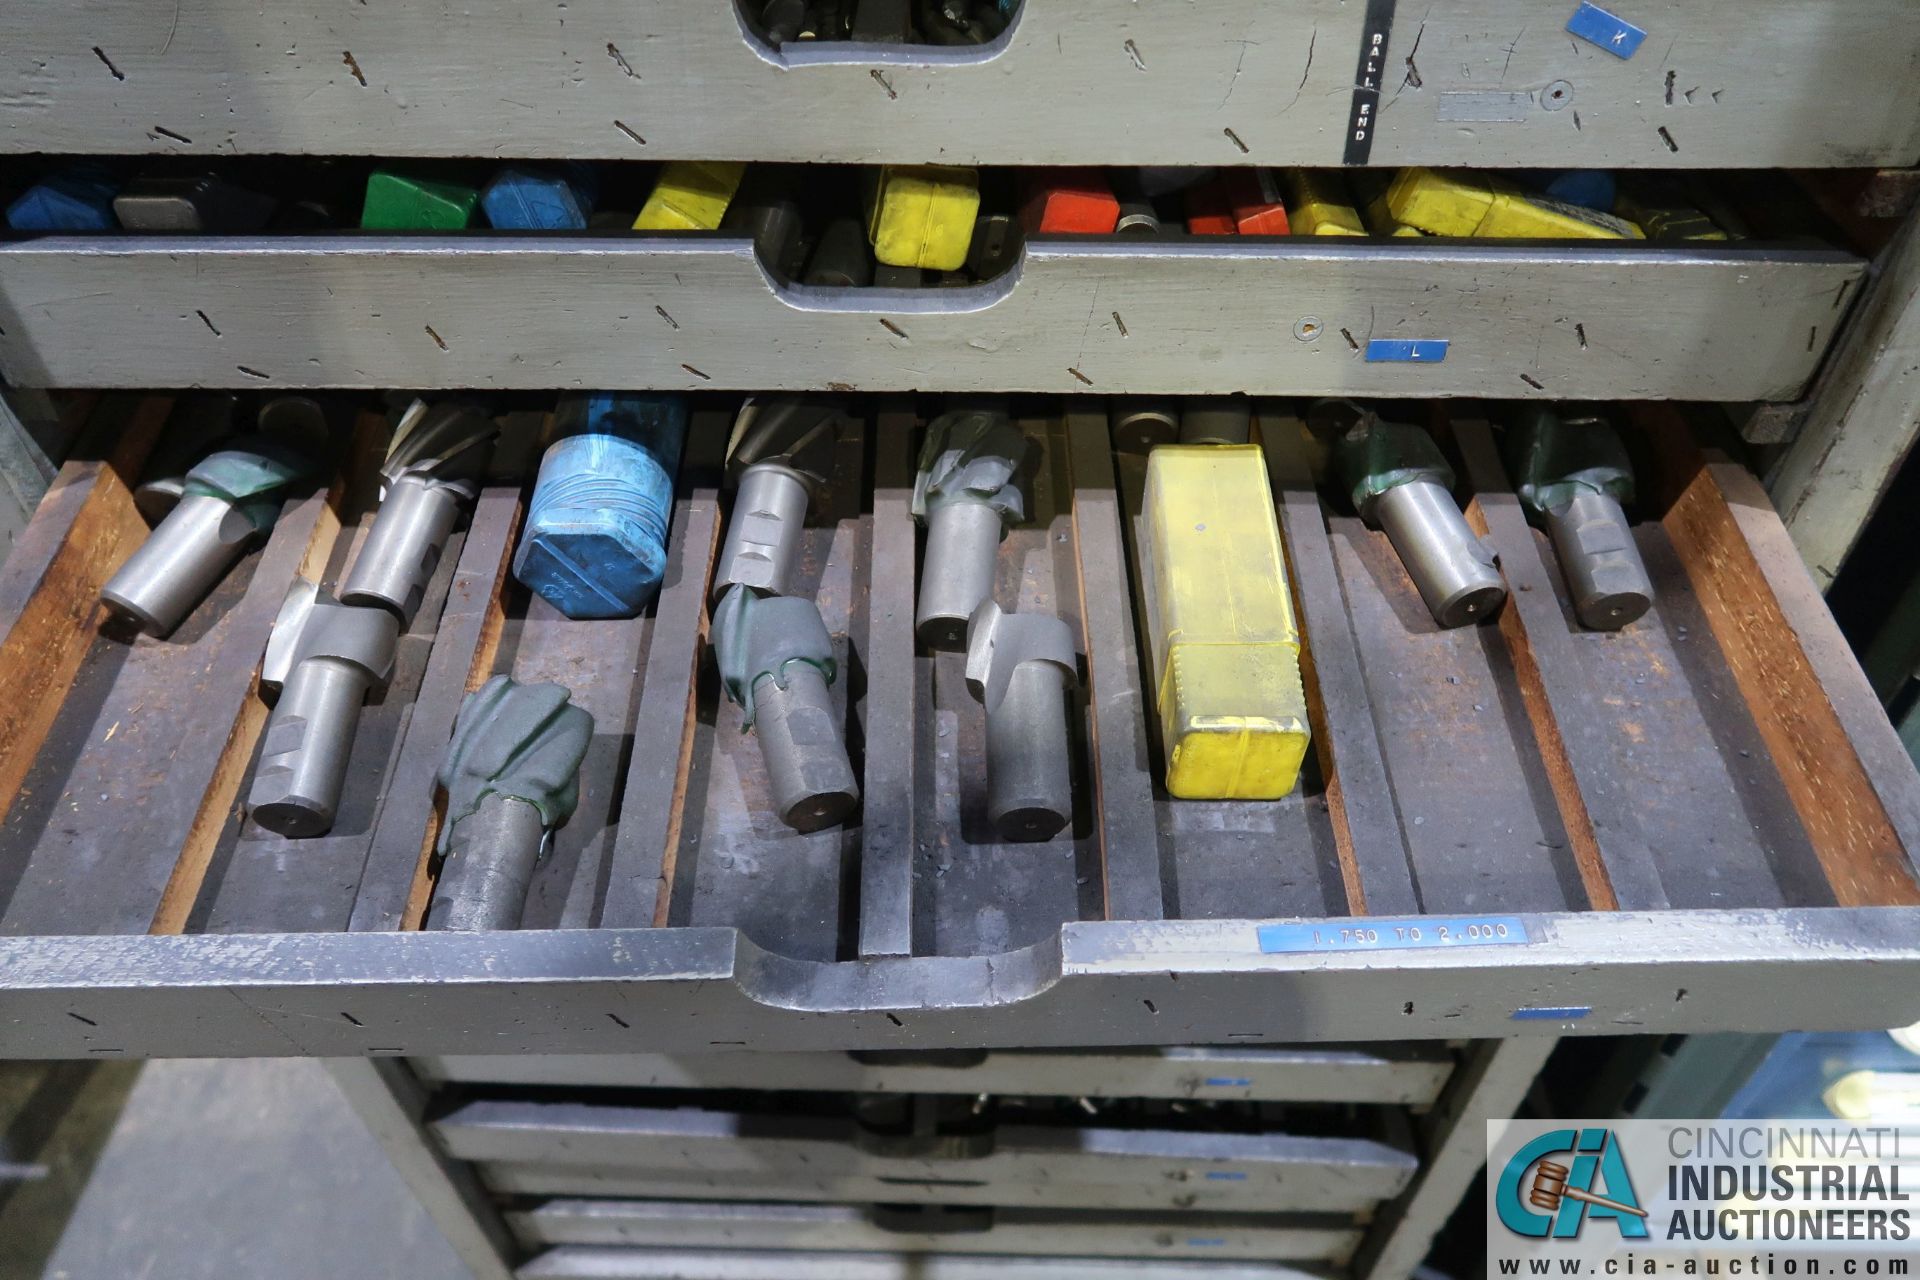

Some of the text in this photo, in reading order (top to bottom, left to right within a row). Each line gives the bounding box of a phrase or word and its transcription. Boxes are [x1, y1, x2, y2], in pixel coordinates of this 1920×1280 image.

[1355, 33, 1383, 141] BALL END
[1411, 345, 1420, 357] L
[1312, 923, 1509, 945] 1.750 TO 2.000
